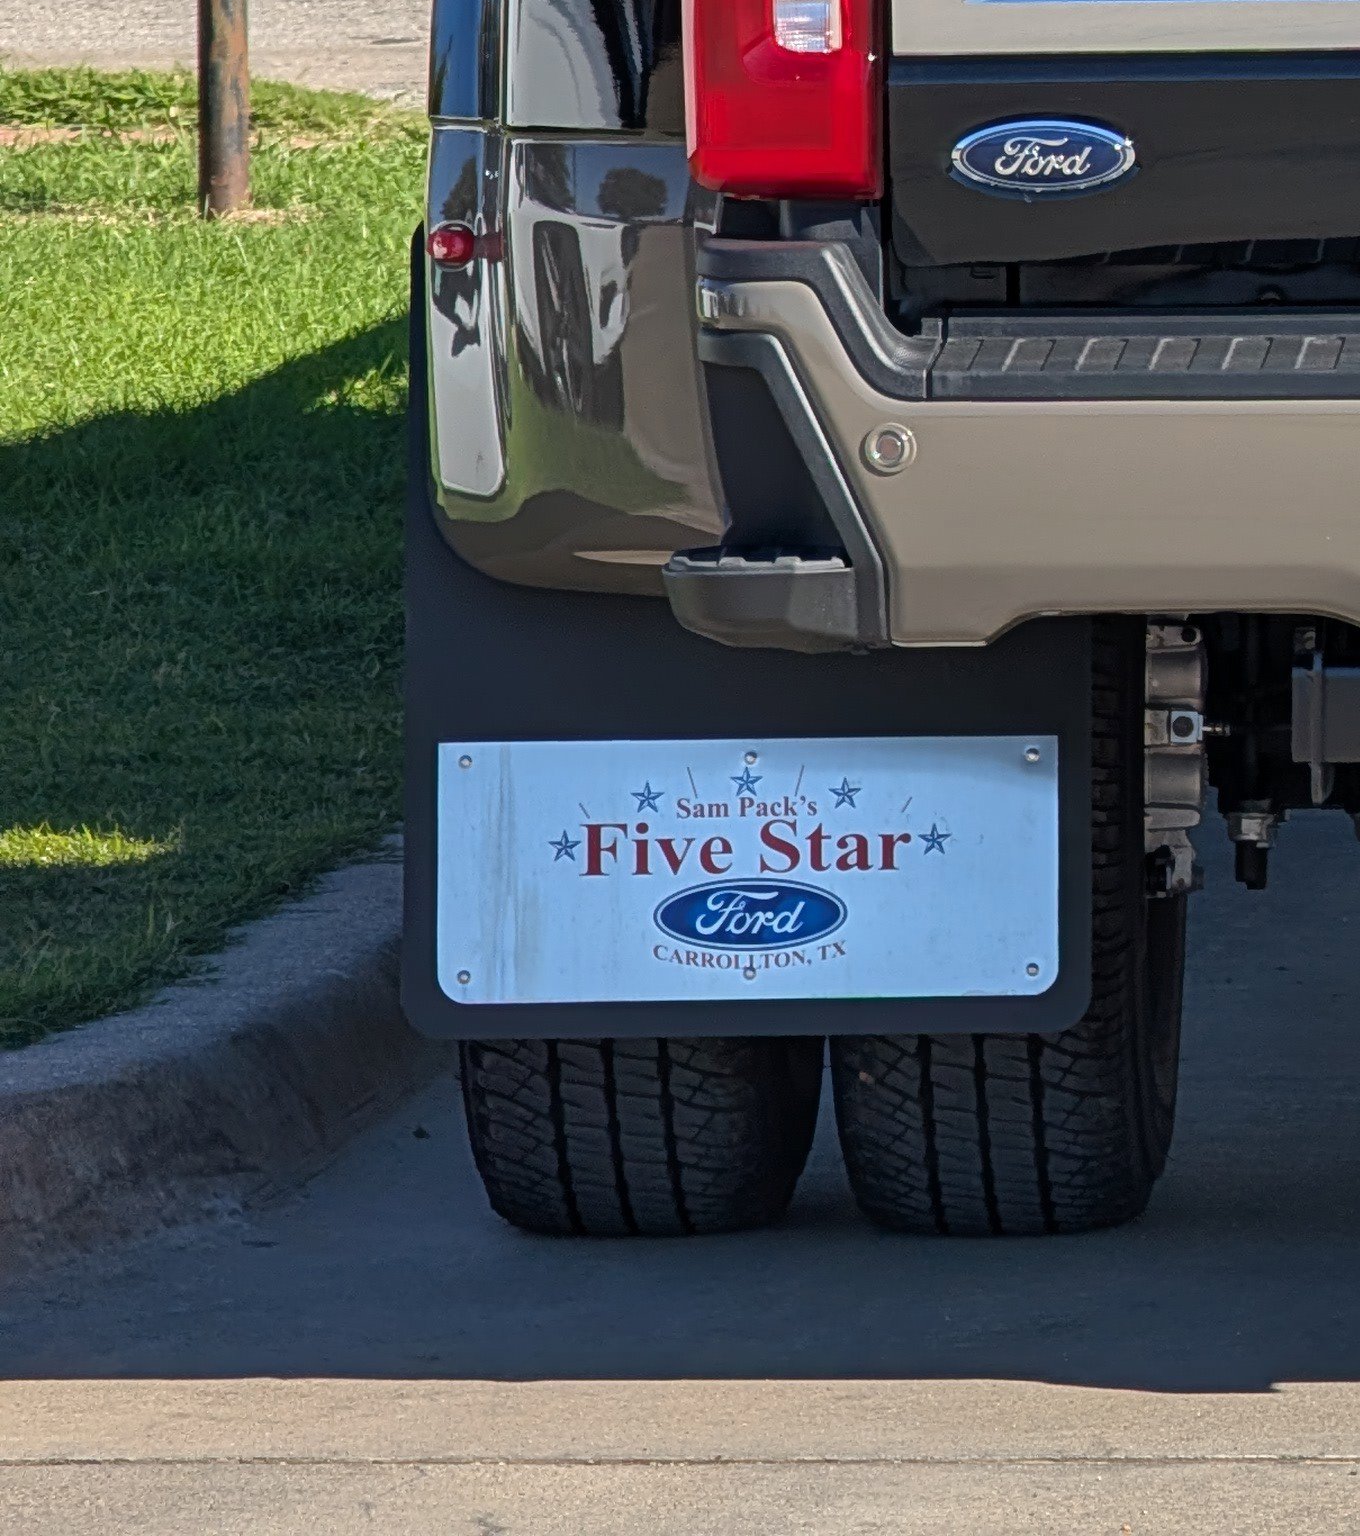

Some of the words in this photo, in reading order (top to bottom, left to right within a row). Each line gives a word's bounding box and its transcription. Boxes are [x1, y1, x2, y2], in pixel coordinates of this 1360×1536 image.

[994, 136, 1093, 176] Ford
[676, 797, 729, 819] Sam
[739, 796, 818, 818] Pack's
[579, 822, 733, 876] Five
[759, 819, 912, 874] Star
[695, 889, 804, 935] Ford
[818, 939, 847, 961] TX
